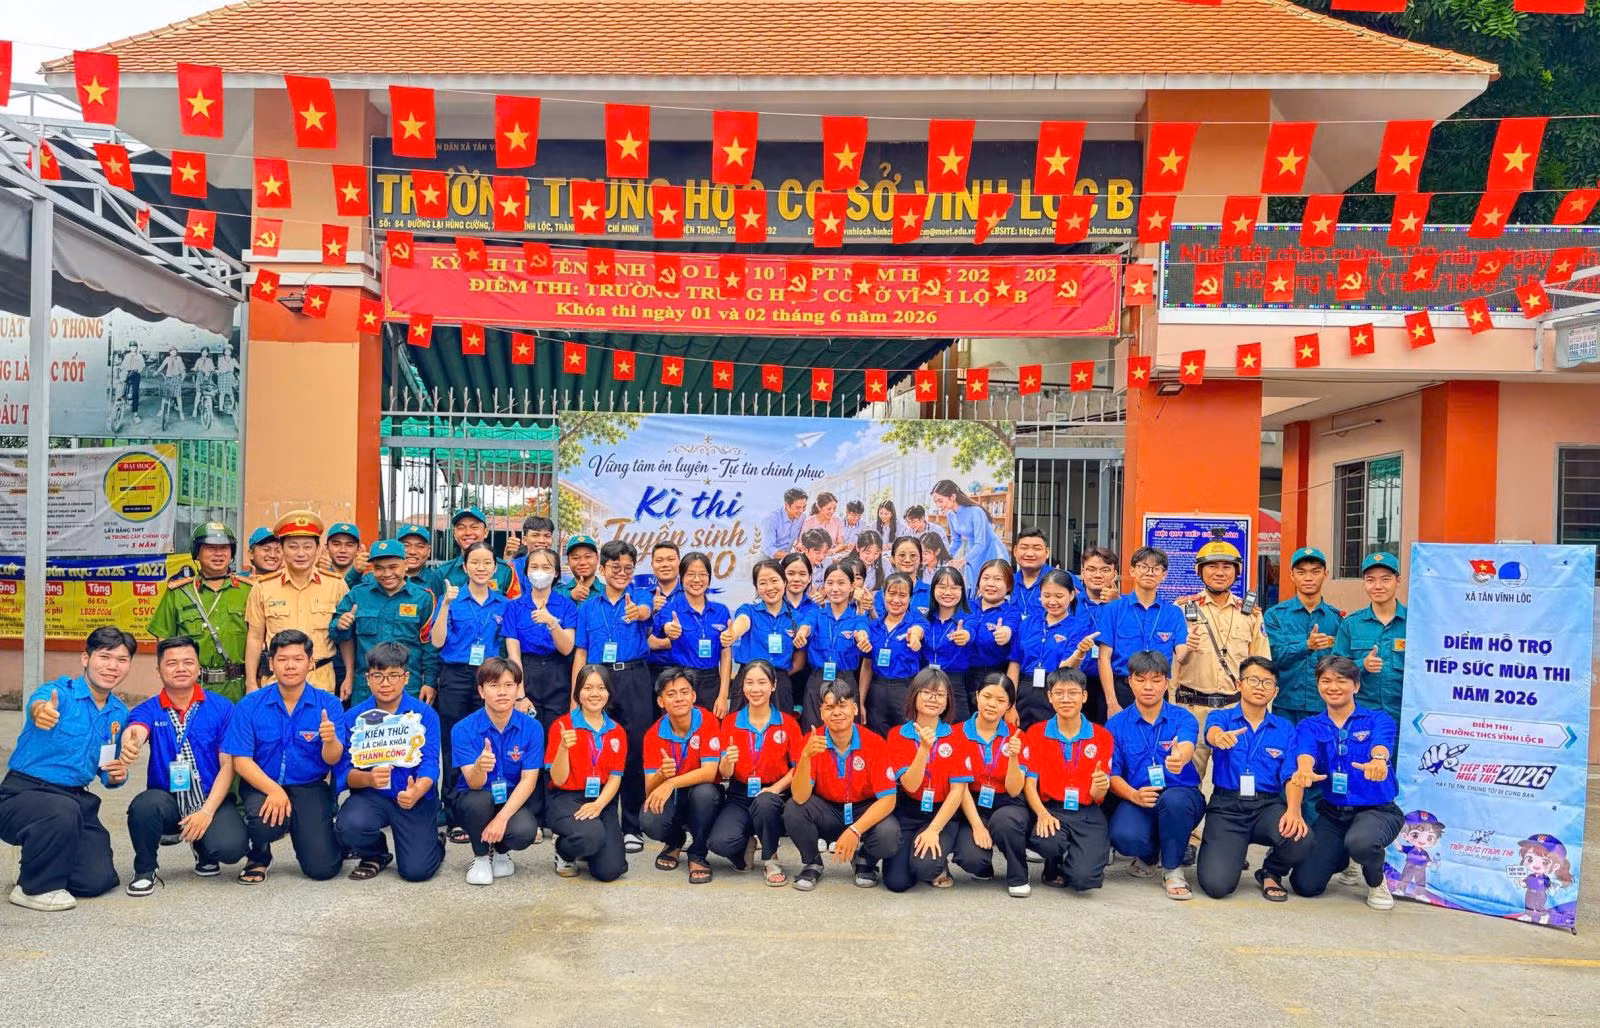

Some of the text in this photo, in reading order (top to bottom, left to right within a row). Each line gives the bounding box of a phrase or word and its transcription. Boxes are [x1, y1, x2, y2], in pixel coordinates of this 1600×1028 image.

[376, 165, 530, 217] TRỜN
[685, 178, 765, 228] HỌ
[1107, 179, 1134, 220] B
[394, 220, 404, 228] 84
[432, 220, 444, 231] LẠI
[555, 222, 575, 232] THÀN
[608, 223, 620, 233] CHÍ
[622, 224, 639, 233] MINH
[697, 225, 720, 236] THOẠI:
[991, 226, 1017, 235] EBSITE:
[431, 253, 461, 270] KỲ
[754, 266, 775, 281] 10
[957, 268, 990, 282] 202
[1024, 268, 1057, 283] 202
[533, 280, 579, 296] THI:
[959, 287, 990, 307] LỘ
[1014, 290, 1029, 304] B
[556, 302, 938, 325] Khóa thi ngày 01 và 02 tháng 6 năm 2026
[15, 354, 30, 381] LÀ
[62, 351, 86, 382] TỐT
[0, 393, 18, 424] ẦU
[632, 457, 656, 473] tâm
[658, 458, 673, 473] ôn
[675, 456, 709, 479] luyện
[719, 458, 740, 478] Tự
[741, 461, 759, 476] tin
[794, 463, 825, 483] phục
[691, 489, 745, 519] thi
[690, 520, 748, 548] sinh
[136, 562, 166, 577] 2027
[45, 582, 63, 596] ặng
[88, 582, 111, 596] Tặng
[1478, 591, 1494, 603] TÂN
[1495, 591, 1515, 603] VĨNH
[1444, 631, 1553, 656] ĐIỂM HỖ TRỢ
[1425, 656, 1571, 682] TIẾP SỨC MÙA THI
[1452, 685, 1539, 706] NĂM 2026
[365, 723, 410, 739] KIẾN THỨC
[1476, 730, 1497, 740] THCS
[385, 748, 406, 758] CÔNG
[1496, 765, 1553, 788] 2026
